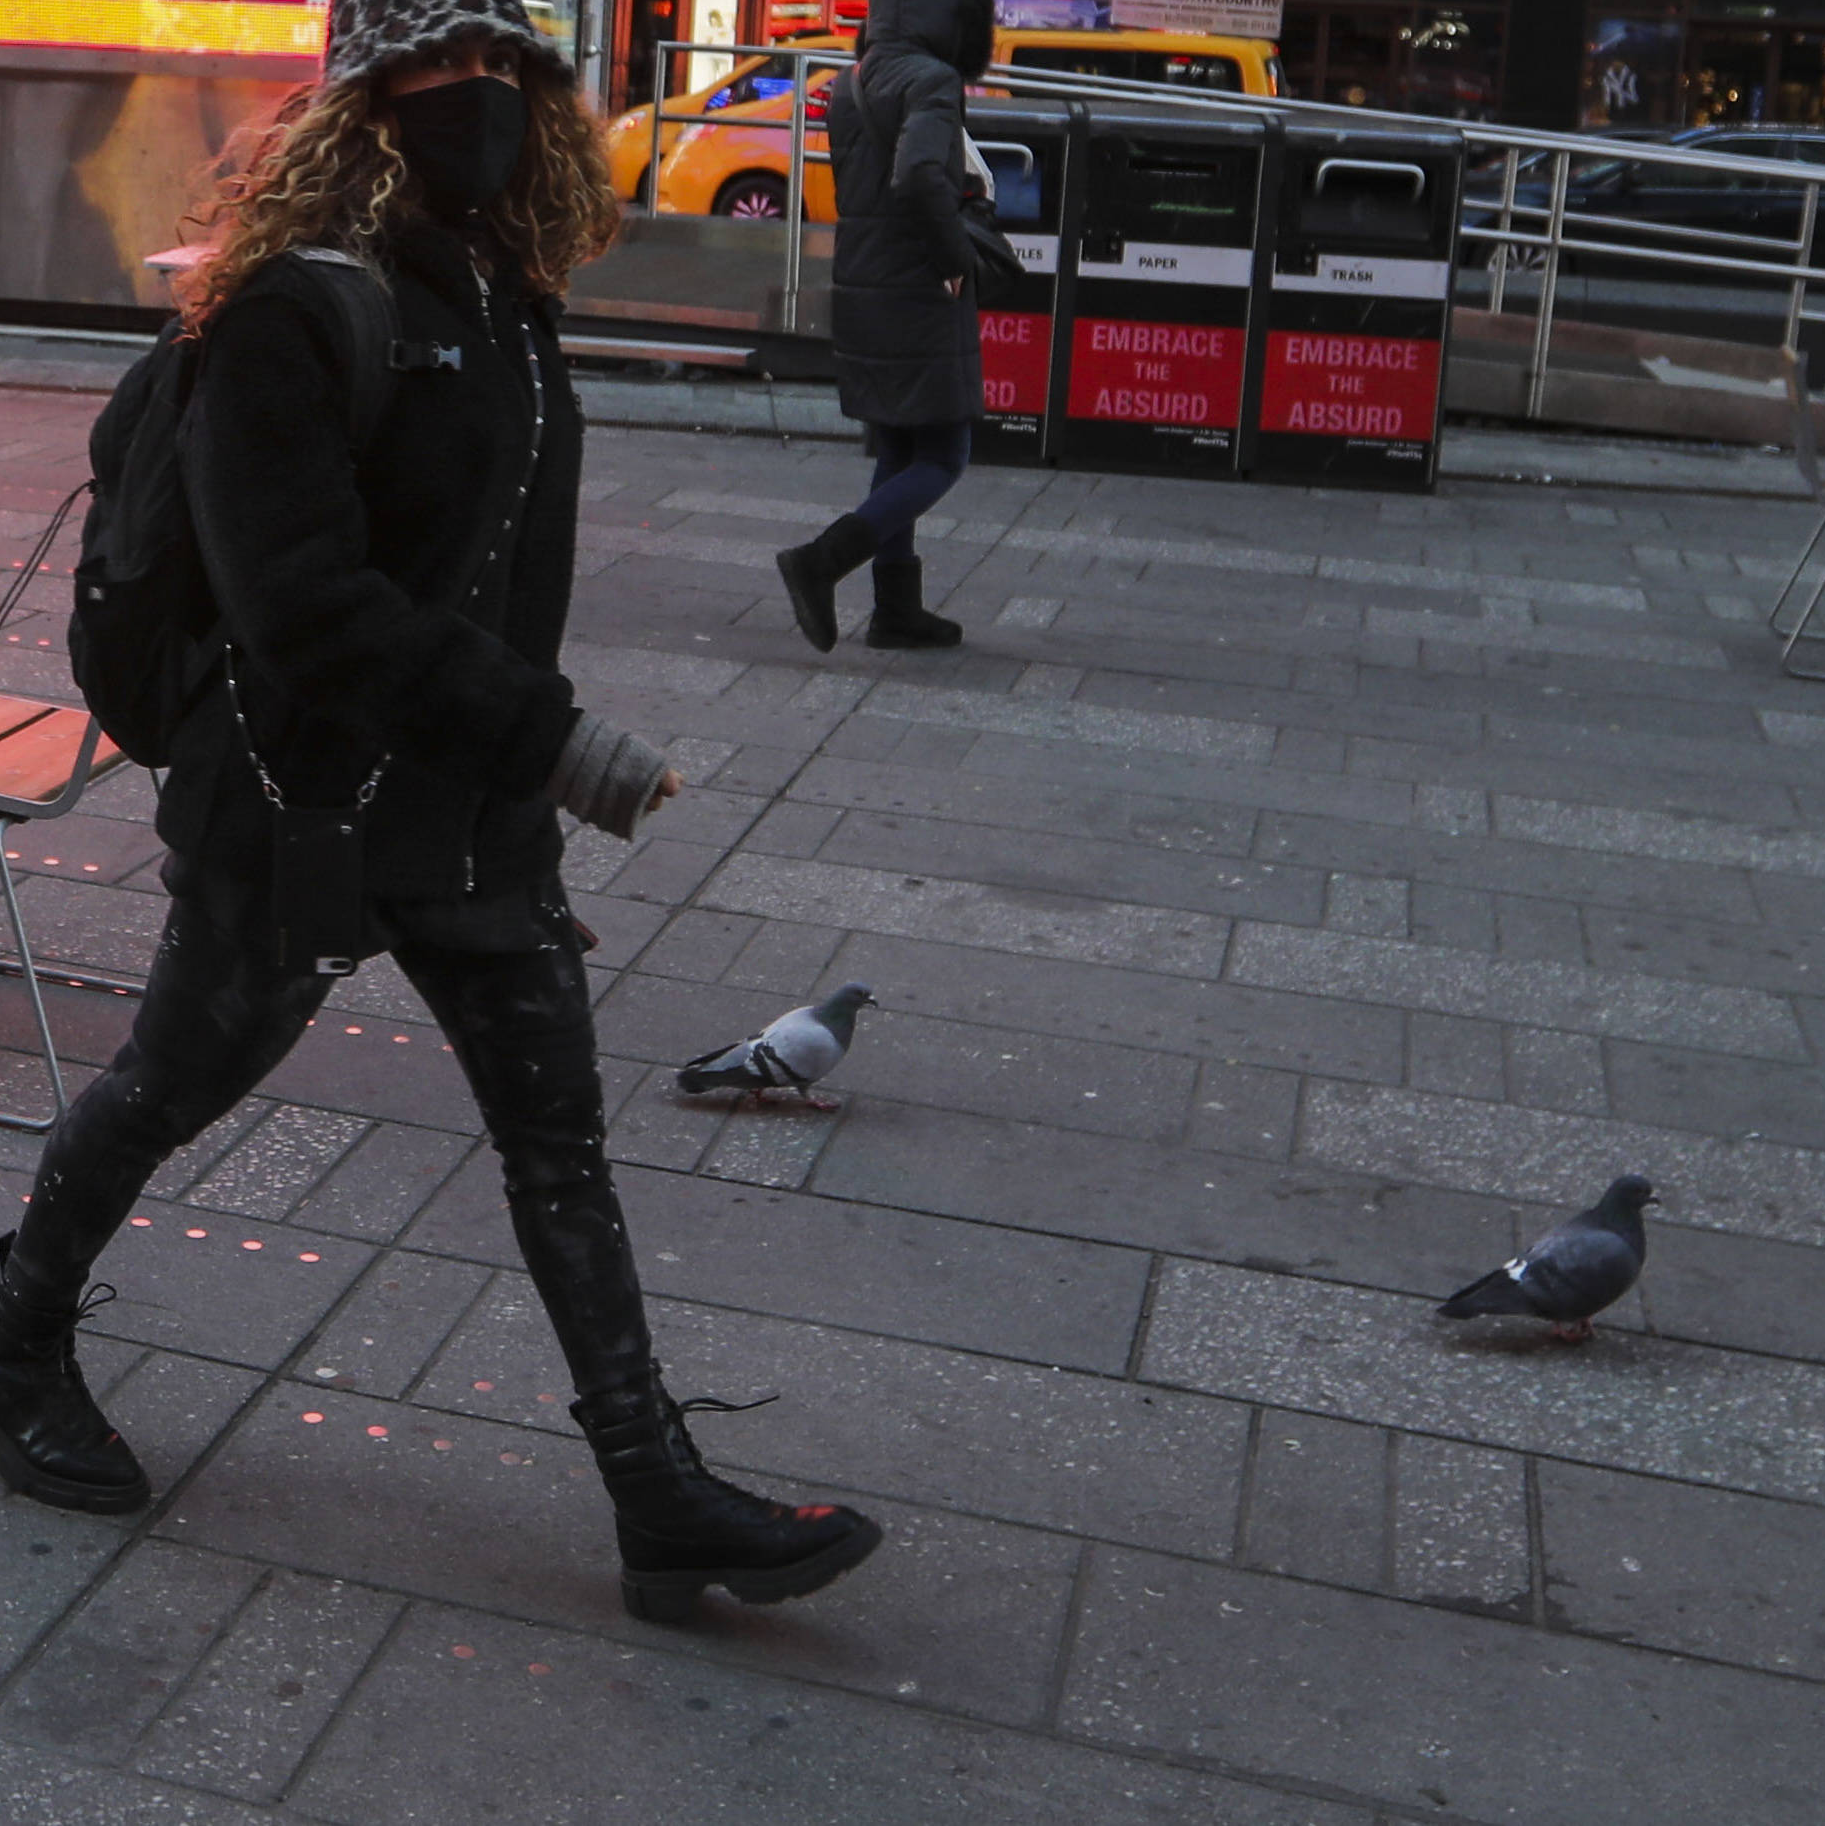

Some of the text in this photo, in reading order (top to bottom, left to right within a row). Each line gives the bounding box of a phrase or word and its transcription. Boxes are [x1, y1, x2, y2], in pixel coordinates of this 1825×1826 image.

[1138, 256, 1178, 270] PAPER
[1332, 268, 1374, 283] TRASH
[1091, 324, 1224, 358] EMBRACE
[1285, 337, 1420, 371] EMBRACE
[1134, 360, 1172, 381] THE
[1328, 374, 1365, 394] THE
[1093, 388, 1209, 422] ABSURD
[1287, 400, 1404, 435] ABSURD
